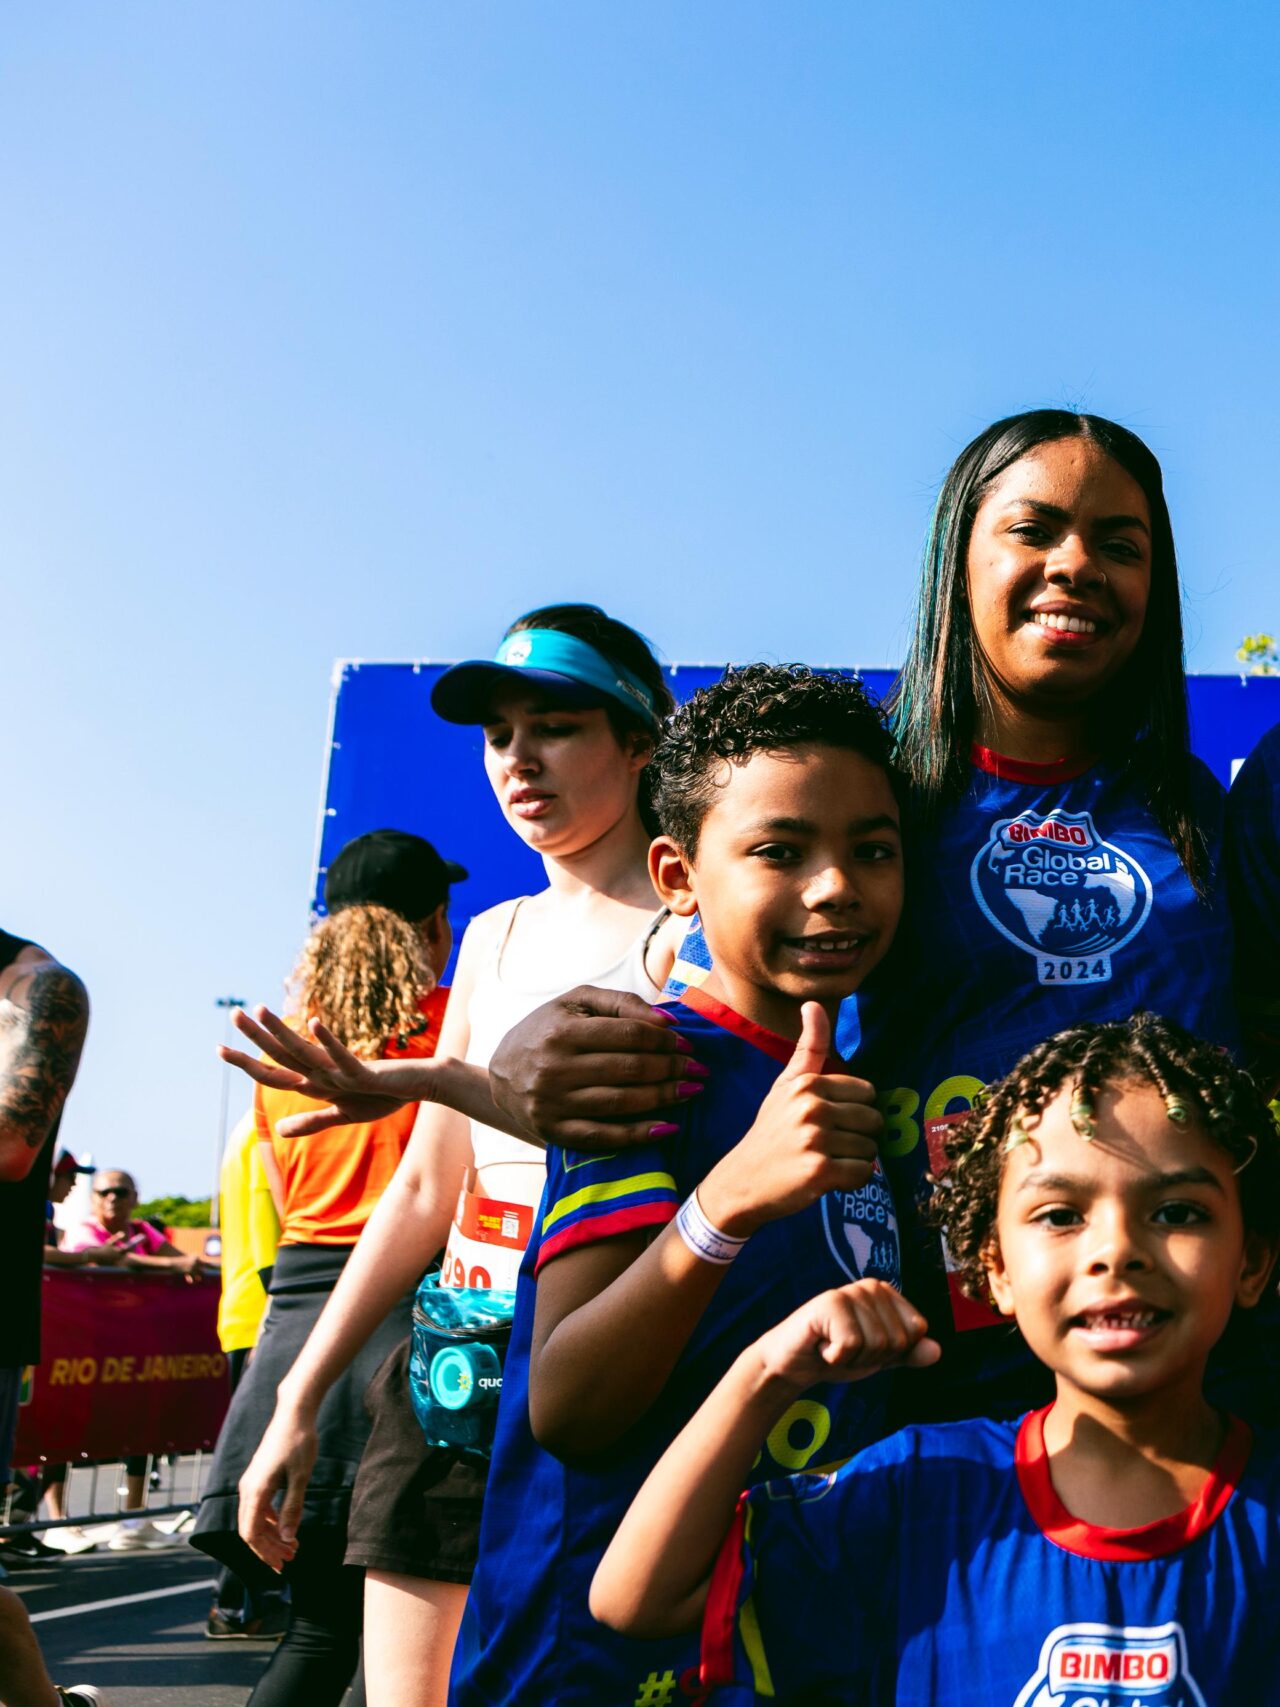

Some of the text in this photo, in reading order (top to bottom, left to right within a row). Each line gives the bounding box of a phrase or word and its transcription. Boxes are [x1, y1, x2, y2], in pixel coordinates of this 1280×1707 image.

[1008, 820, 1087, 845] BIMBO
[1021, 846, 1111, 872] Global
[1003, 863, 1080, 886] Race
[1043, 959, 1106, 981] 2024
[843, 1193, 886, 1224] Race
[50, 1354, 225, 1386] RIO DE JANEIRO
[1059, 1652, 1170, 1682] BIMBO
